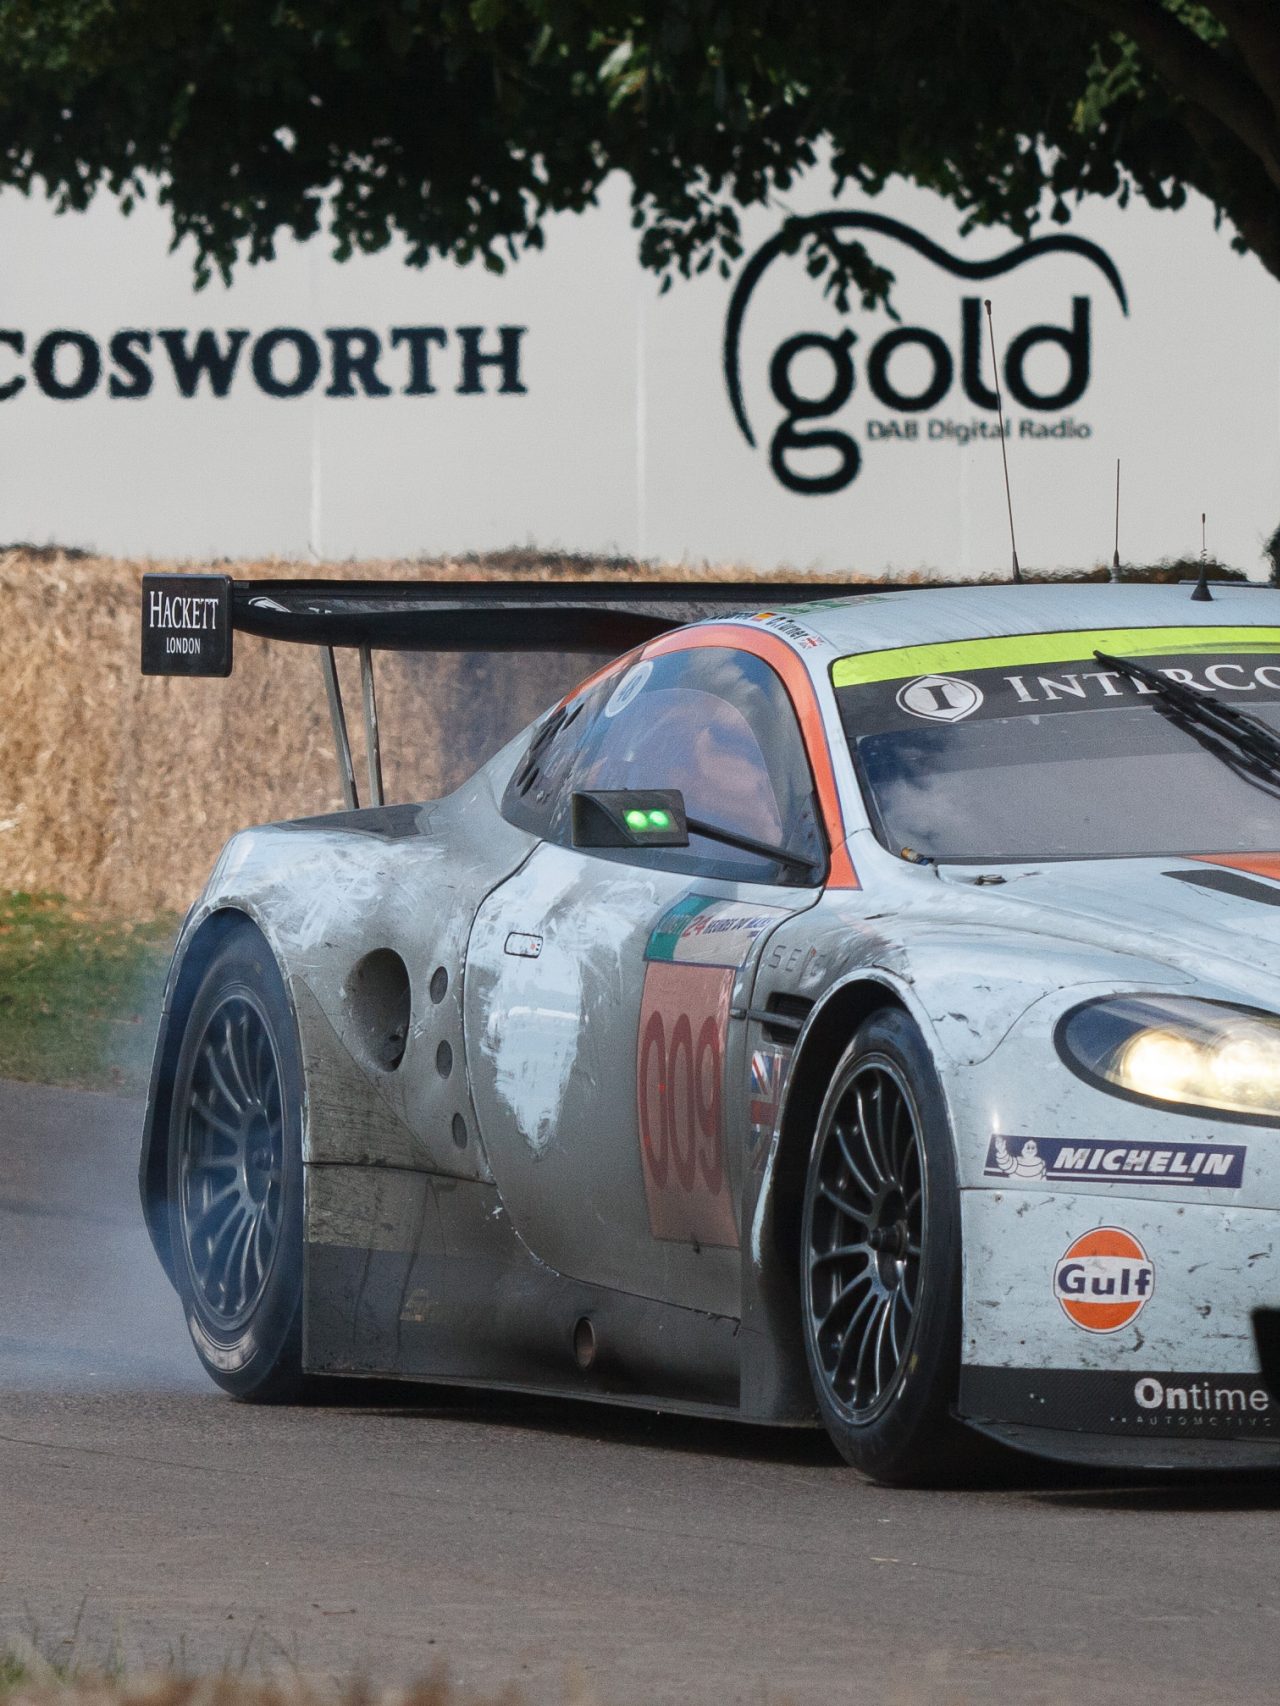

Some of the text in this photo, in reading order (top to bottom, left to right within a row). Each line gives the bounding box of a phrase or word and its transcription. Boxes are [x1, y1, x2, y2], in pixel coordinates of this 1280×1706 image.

[769, 296, 1091, 495] gold
[867, 418, 1092, 445] DAB Digital Radio
[149, 590, 219, 630] HACKETT
[166, 636, 201, 654] LONDON
[639, 1009, 723, 1196] 009
[1053, 1146, 1236, 1177] MICHELIN
[1057, 1263, 1152, 1297] Gulf
[1134, 1377, 1270, 1412] Ontime
